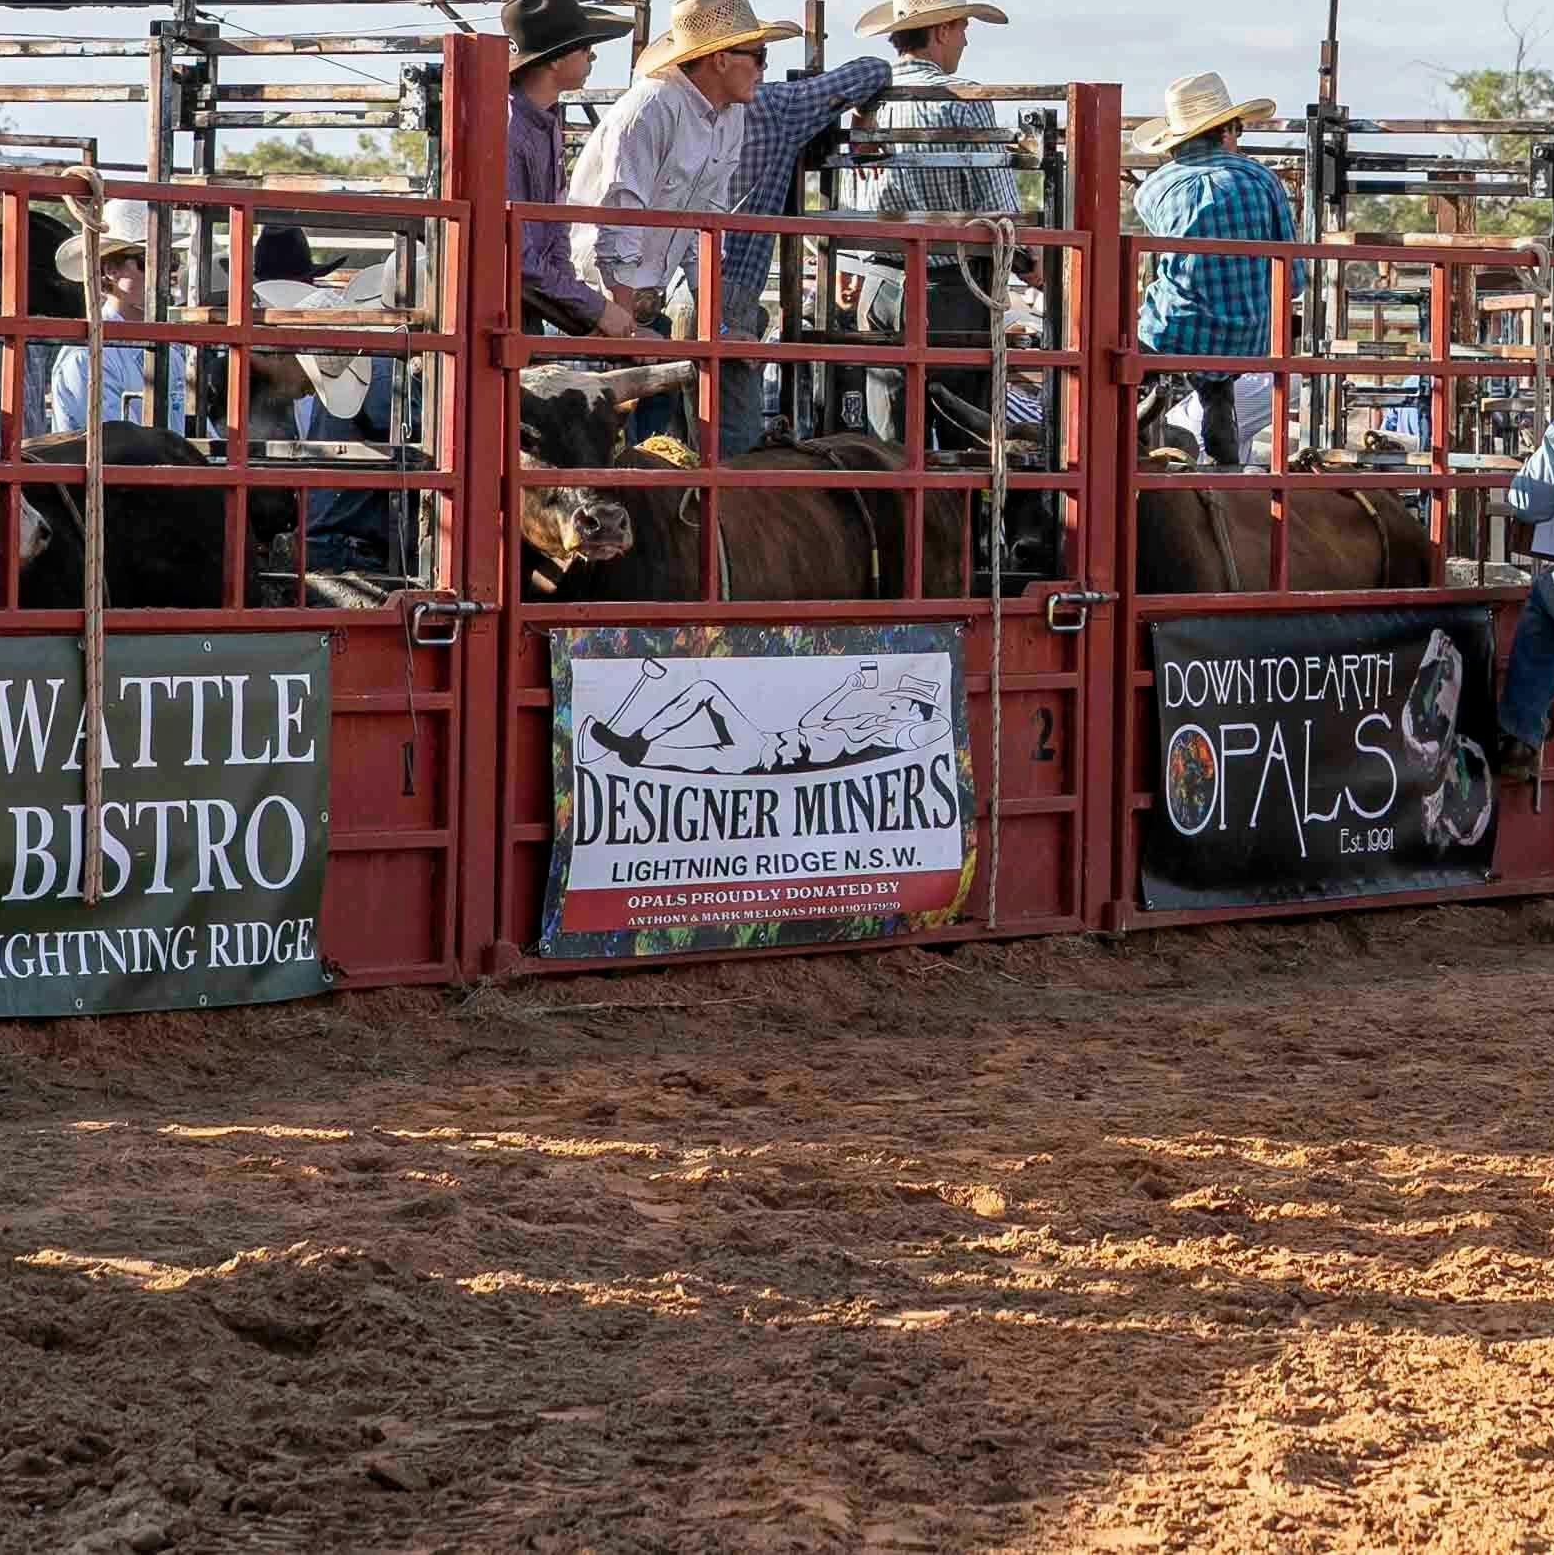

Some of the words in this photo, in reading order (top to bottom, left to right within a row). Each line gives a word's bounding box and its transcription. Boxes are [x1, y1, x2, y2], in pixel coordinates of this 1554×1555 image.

[1165, 658, 1255, 708] DOWN
[1261, 656, 1299, 704] TO
[1304, 652, 1394, 711] EARTH
[574, 765, 781, 847] DESIGNER
[793, 754, 957, 837] MINERS
[1165, 713, 1397, 858] OPALS
[1, 795, 306, 901] BISTRO
[611, 855, 747, 883] LIGHTNING
[756, 851, 838, 876] RIDGE
[845, 847, 922, 871] N.S.W.
[628, 893, 687, 909] OPALS
[691, 888, 782, 905] PROUDLY
[786, 883, 873, 900] DONATED
[876, 881, 900, 894] BY
[628, 913, 688, 926] ANTHONY
[701, 910, 741, 922] MARK
[743, 906, 806, 919] MELONAS
[207, 917, 316, 969] RIDGE
